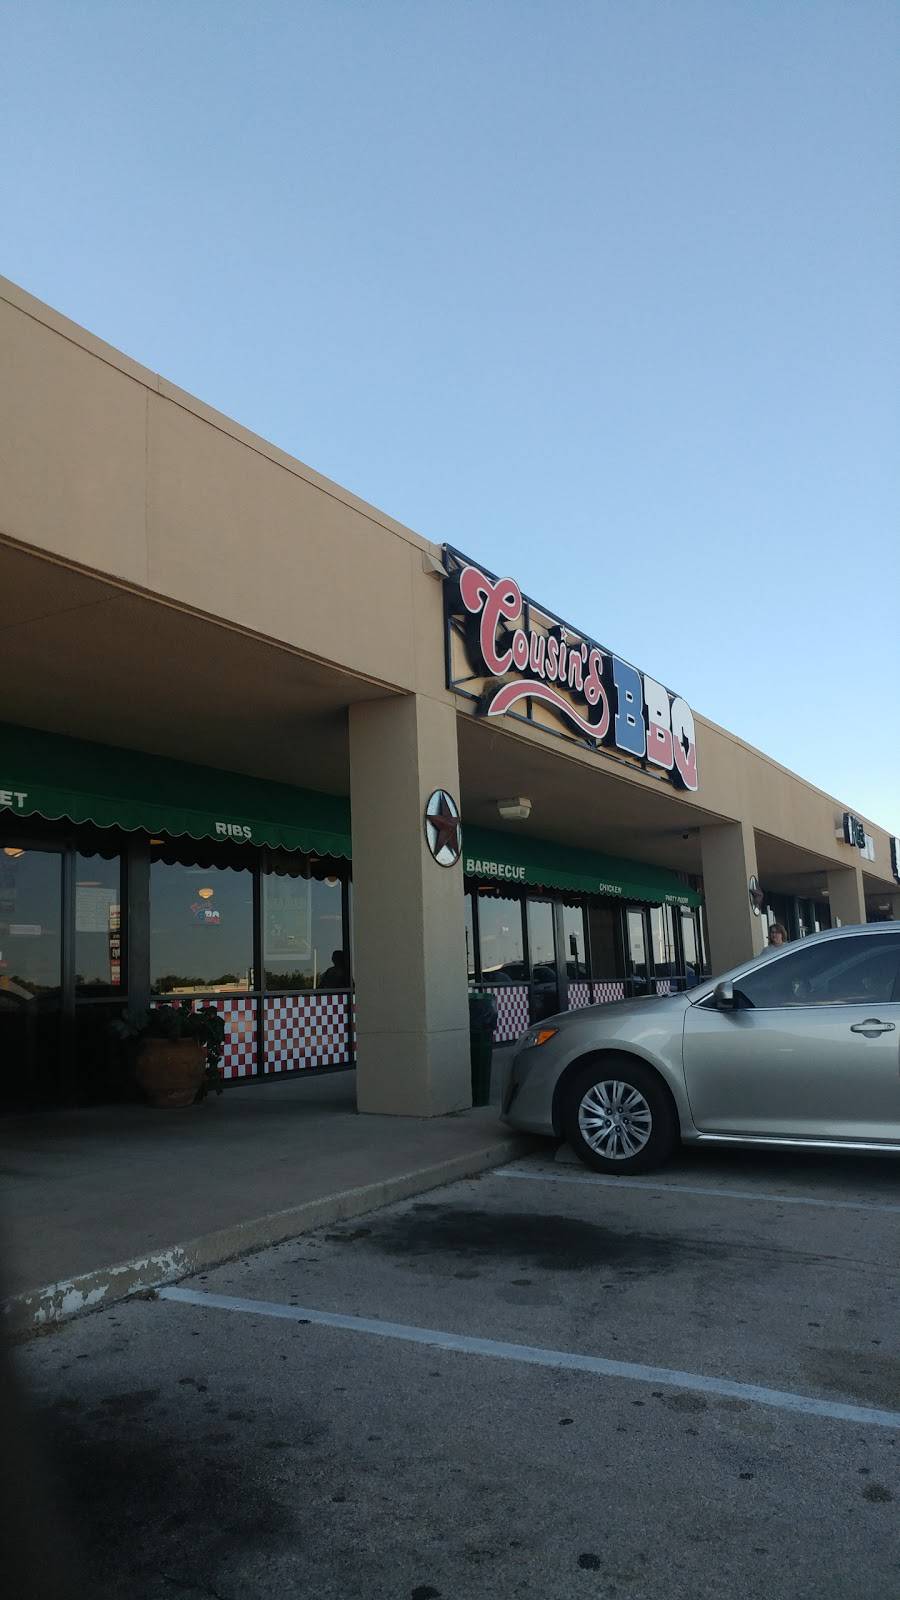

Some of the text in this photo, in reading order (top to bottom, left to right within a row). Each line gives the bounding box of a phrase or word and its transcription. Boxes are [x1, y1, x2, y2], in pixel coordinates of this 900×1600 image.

[459, 565, 698, 792] Cousin's BBQ
[215, 822, 252, 838] RIBS
[466, 858, 526, 879] BARBECUE
[599, 882, 622, 894] CHICKEN
